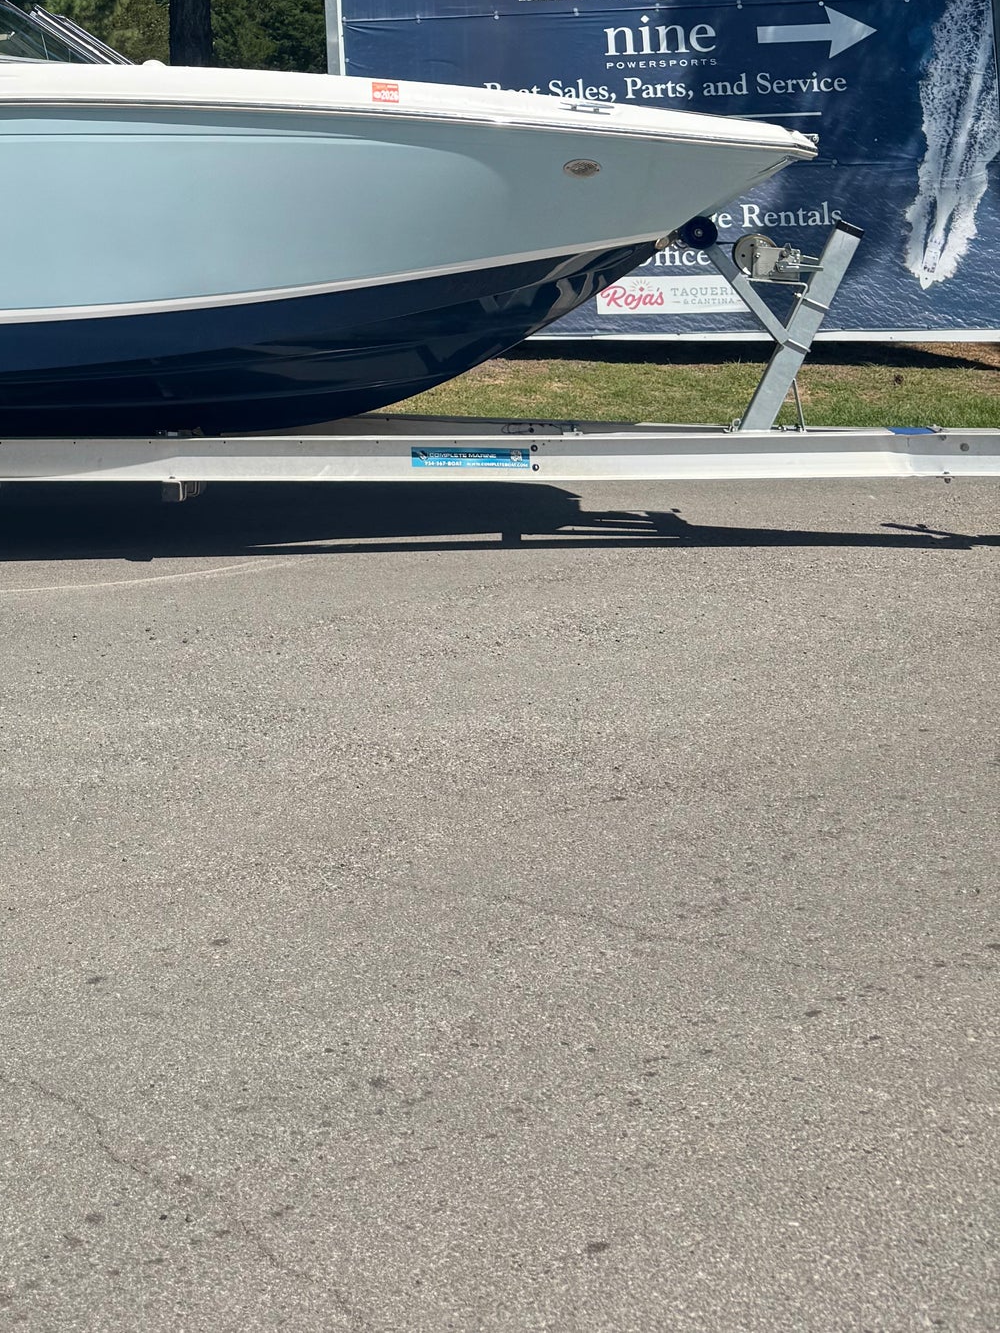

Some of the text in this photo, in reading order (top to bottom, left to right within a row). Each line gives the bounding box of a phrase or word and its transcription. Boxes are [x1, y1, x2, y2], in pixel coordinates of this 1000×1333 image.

[603, 14, 717, 56] nine
[606, 58, 718, 69] POWERSPORTS
[548, 78, 617, 103] Sales,
[624, 76, 694, 103] Parts,
[702, 73, 748, 96] and
[756, 71, 848, 93] Service
[740, 201, 842, 228] Rentals
[639, 242, 711, 267] ffice
[670, 285, 736, 298] TAQUERI
[691, 297, 735, 305] CANTINA
